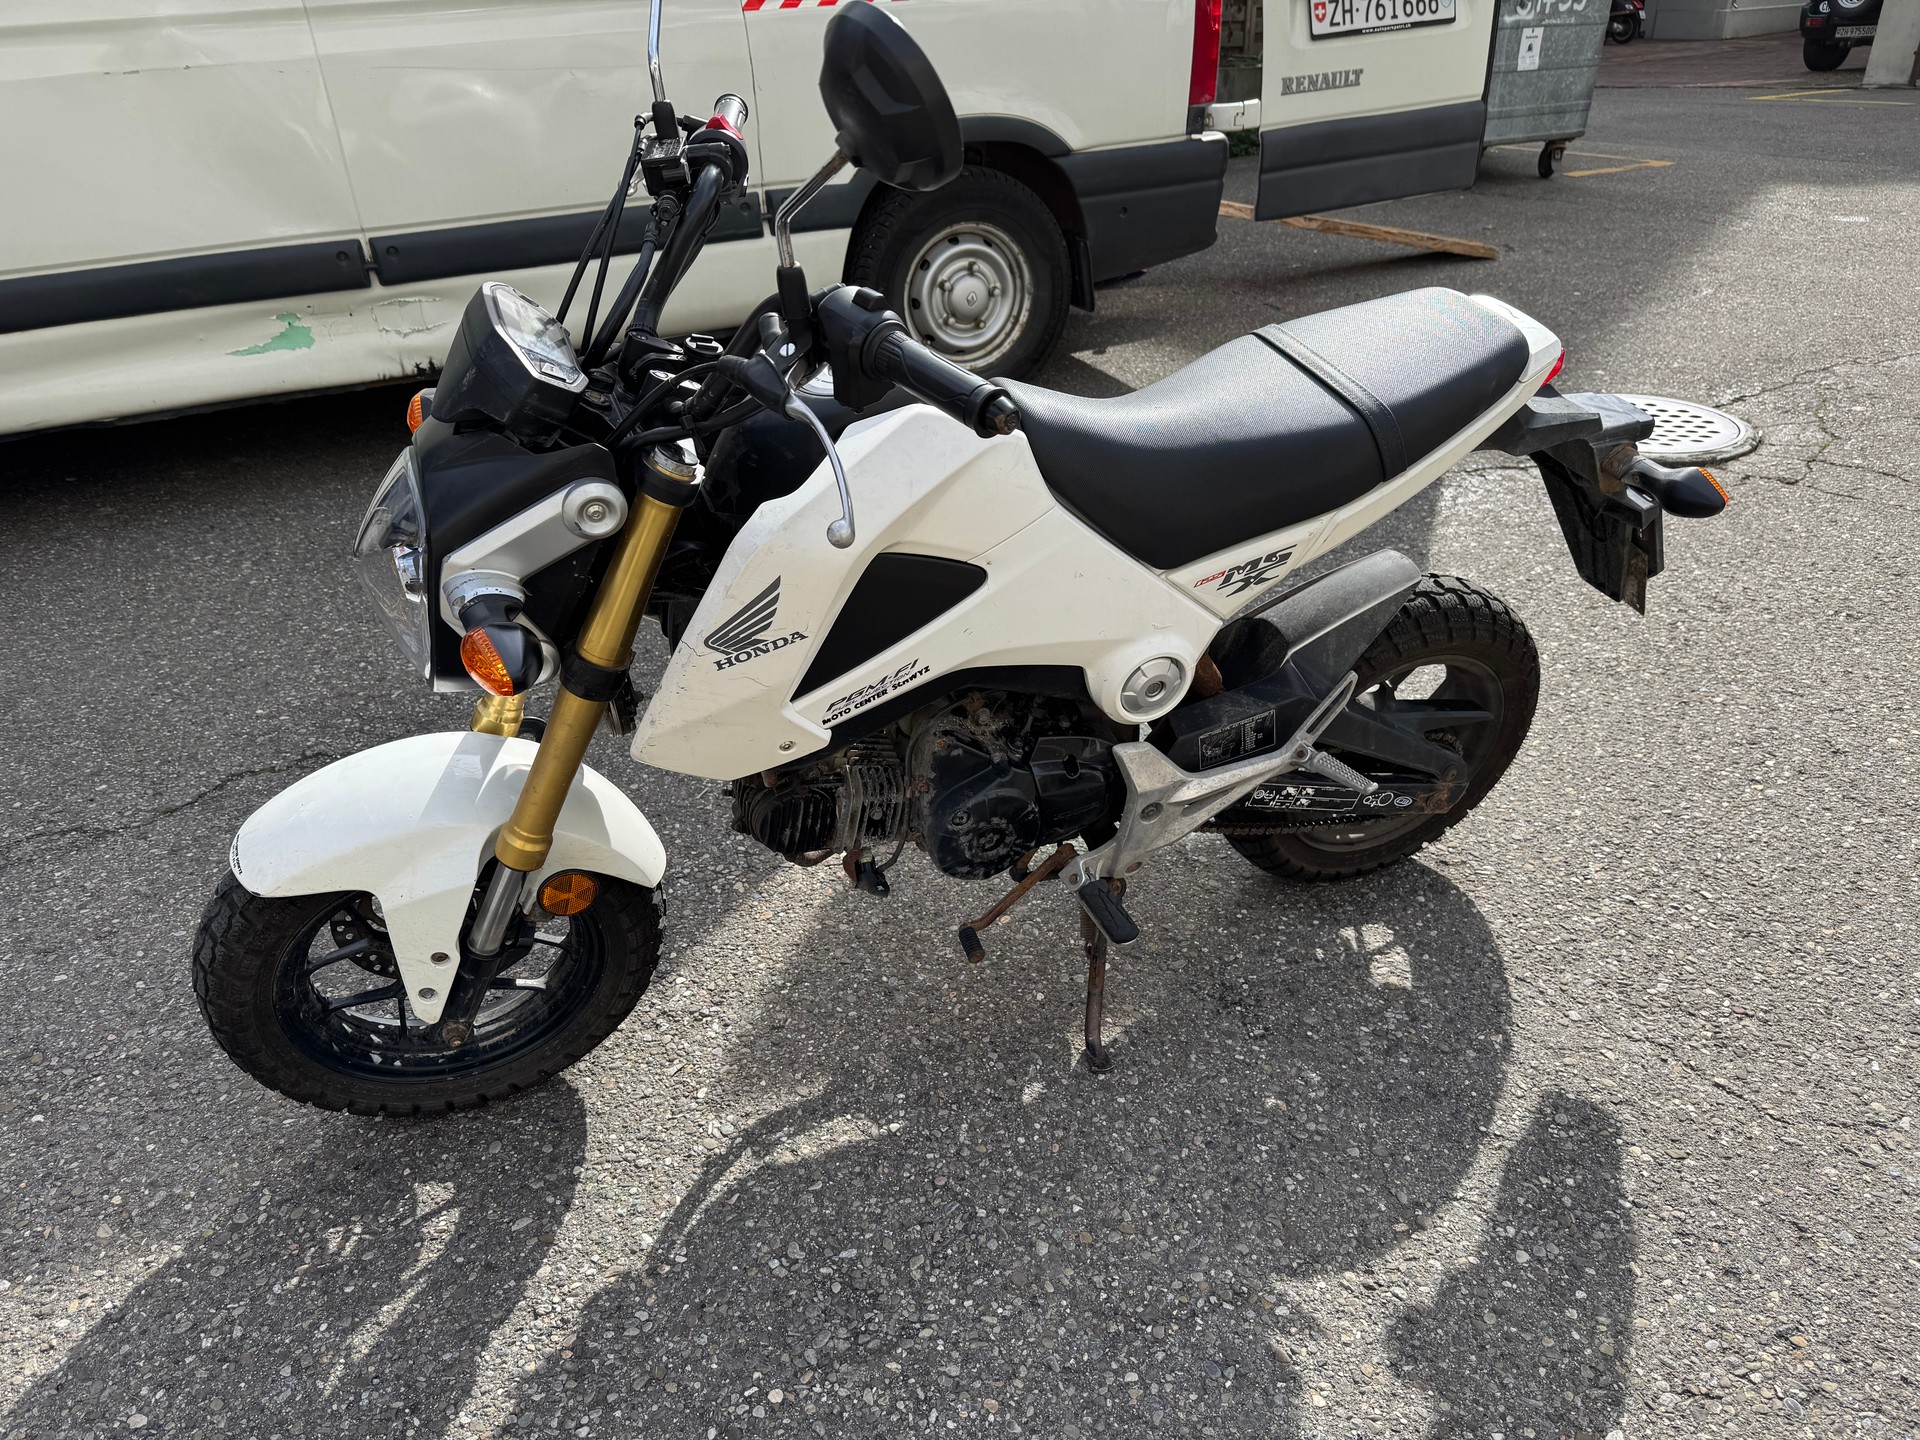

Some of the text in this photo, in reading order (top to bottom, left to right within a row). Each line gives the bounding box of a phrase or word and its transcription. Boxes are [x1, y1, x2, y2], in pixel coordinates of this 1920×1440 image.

[1281, 68, 1364, 96] RENAULT
[713, 631, 809, 671] HONDA
[826, 658, 919, 712] PGM-FI
[822, 707, 842, 725] MOTO
[854, 688, 888, 709] CENTER
